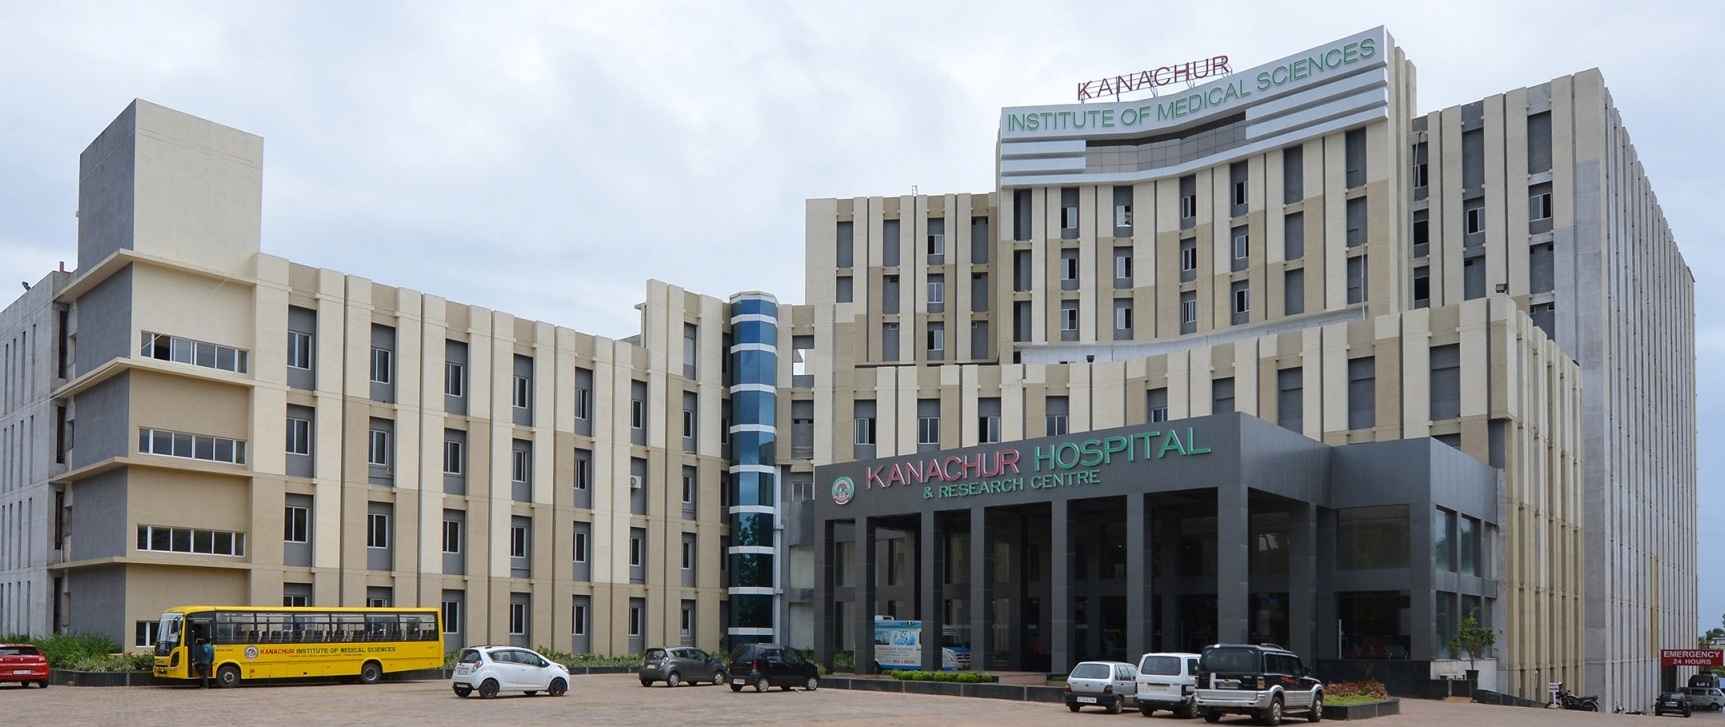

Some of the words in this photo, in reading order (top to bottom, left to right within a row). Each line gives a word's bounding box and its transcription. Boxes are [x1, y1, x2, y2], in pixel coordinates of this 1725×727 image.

[1007, 109, 1115, 131] INSTITUTE
[1120, 105, 1151, 127] OF
[1157, 79, 1252, 122] MEDICAL
[1256, 38, 1376, 91] SCIENCES
[1077, 55, 1230, 100] KANACHUR
[865, 448, 1020, 489] KANACHUR
[1034, 427, 1211, 472] HOSPITAL
[923, 486, 933, 499] &
[939, 477, 1024, 498] RESEARCH
[1031, 469, 1100, 489] CENTRE
[1663, 650, 1720, 658] EMERGENCY
